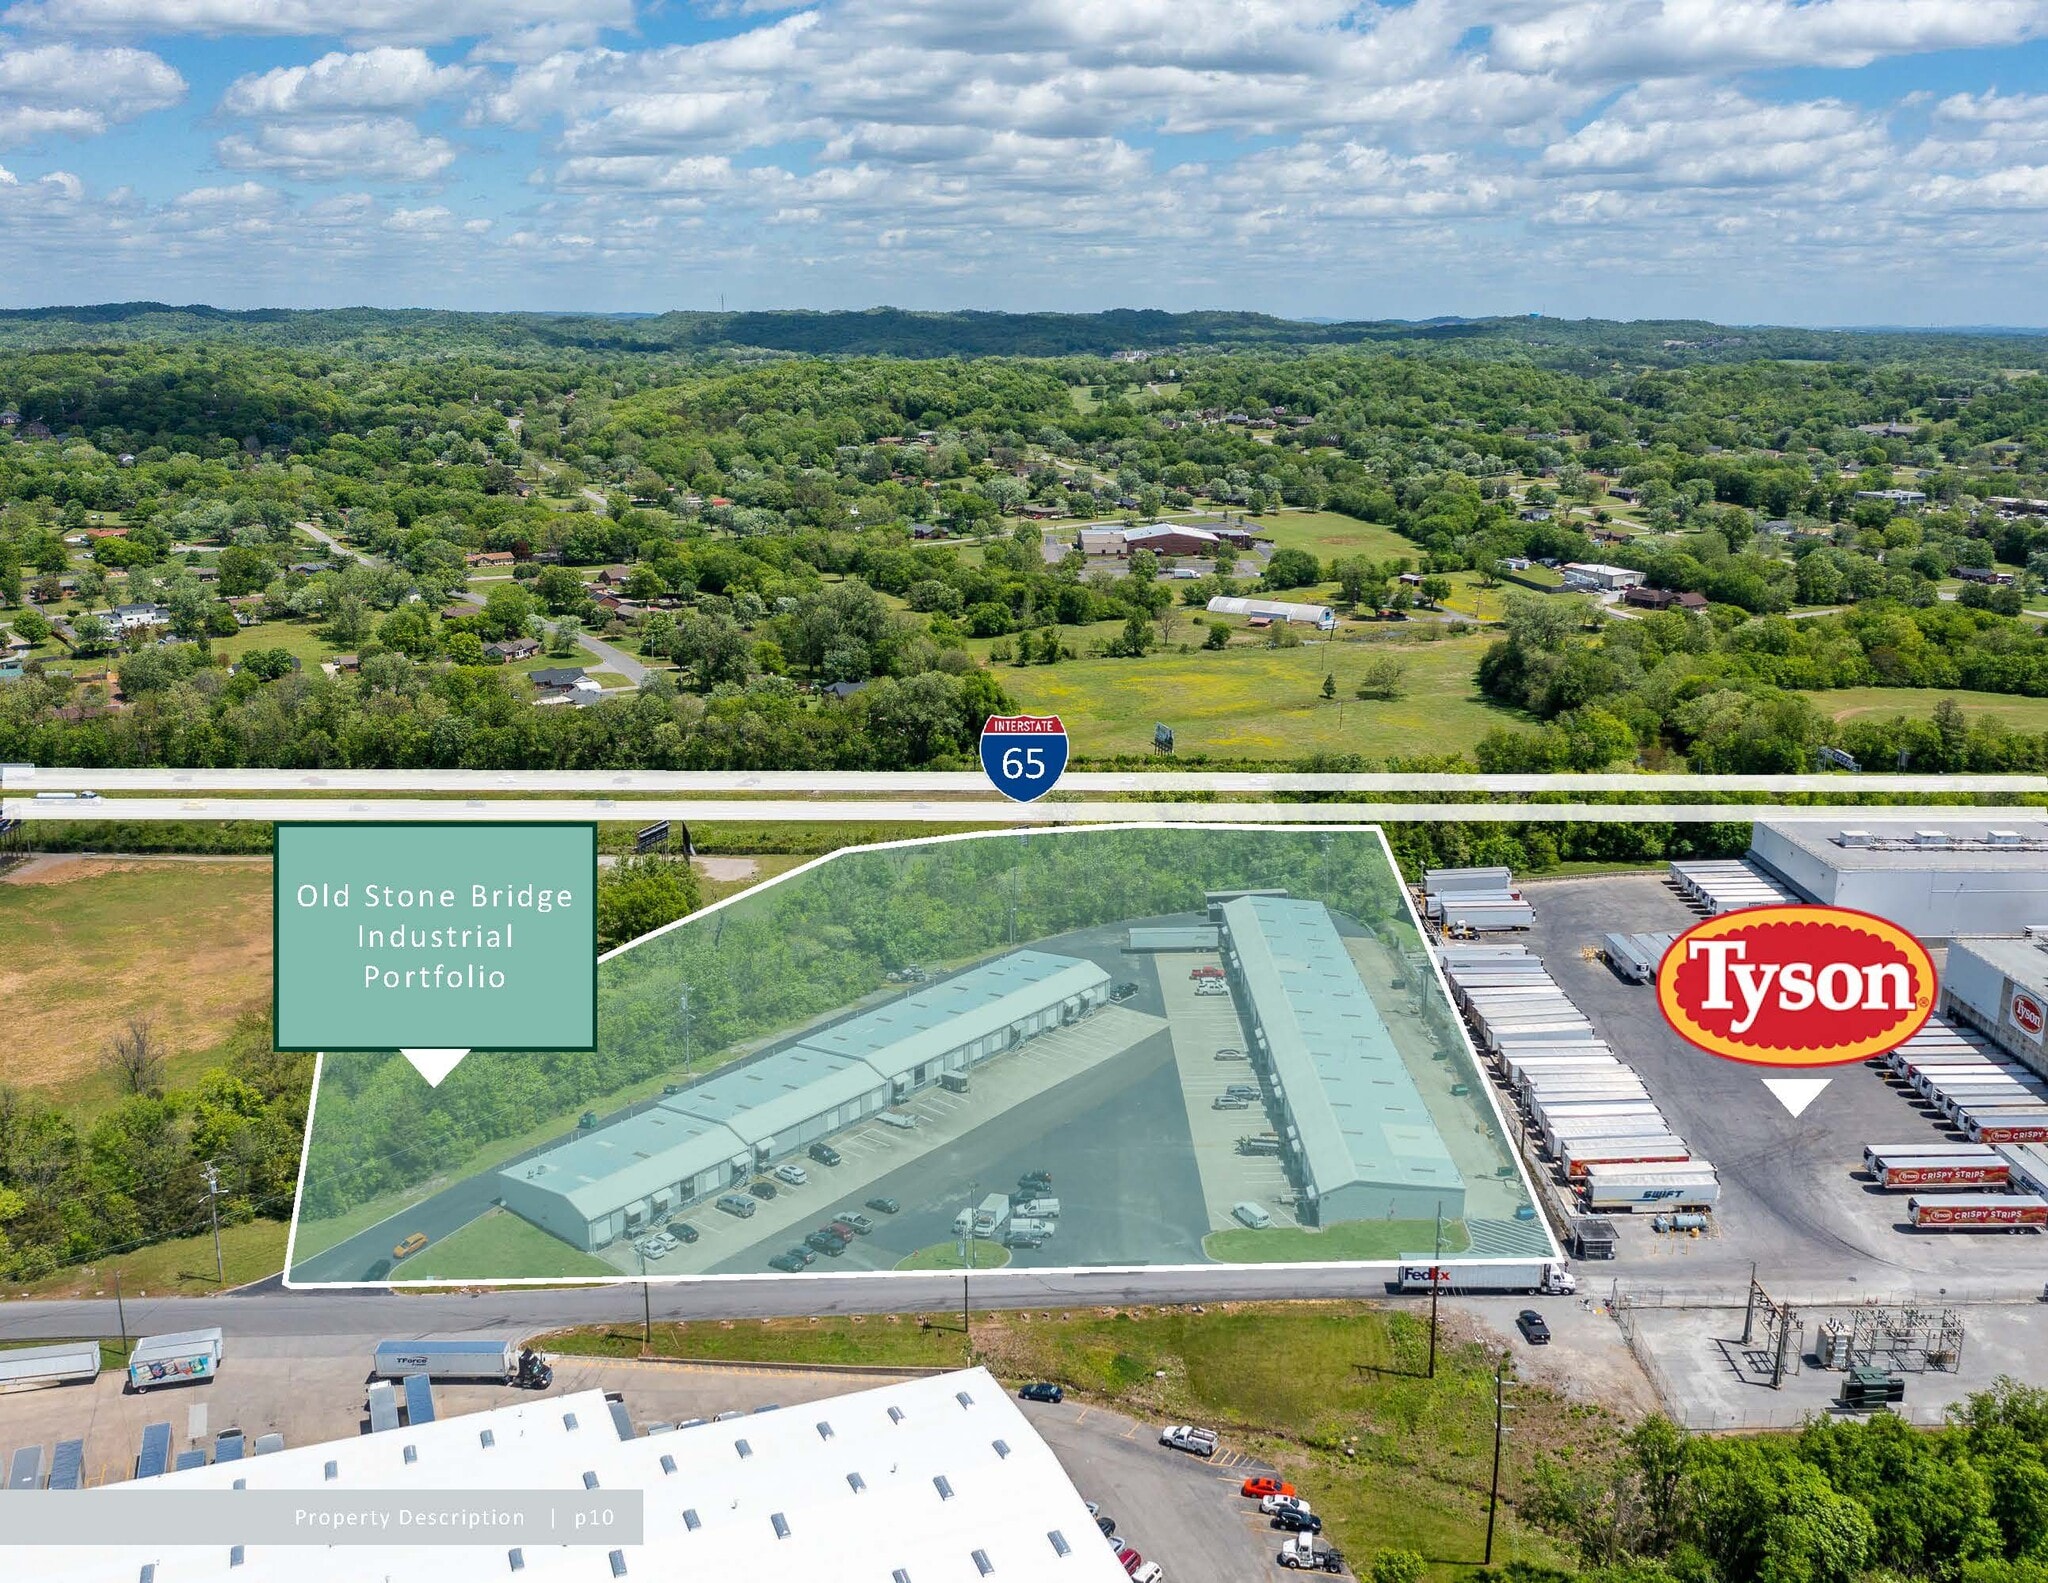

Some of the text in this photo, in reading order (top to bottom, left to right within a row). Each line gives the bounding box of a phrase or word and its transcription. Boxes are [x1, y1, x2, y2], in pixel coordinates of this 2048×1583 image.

[2016, 999, 2041, 1028] Tyson
[2012, 1131, 2044, 1140] CRISPY
[1921, 1171, 1953, 1180] CRISPY
[1955, 1170, 1985, 1178] STRIPS
[1642, 1190, 1684, 1199] SWIFT
[1954, 1211, 1988, 1219] CRISPY
[1990, 1210, 2022, 1219] STRIPS
